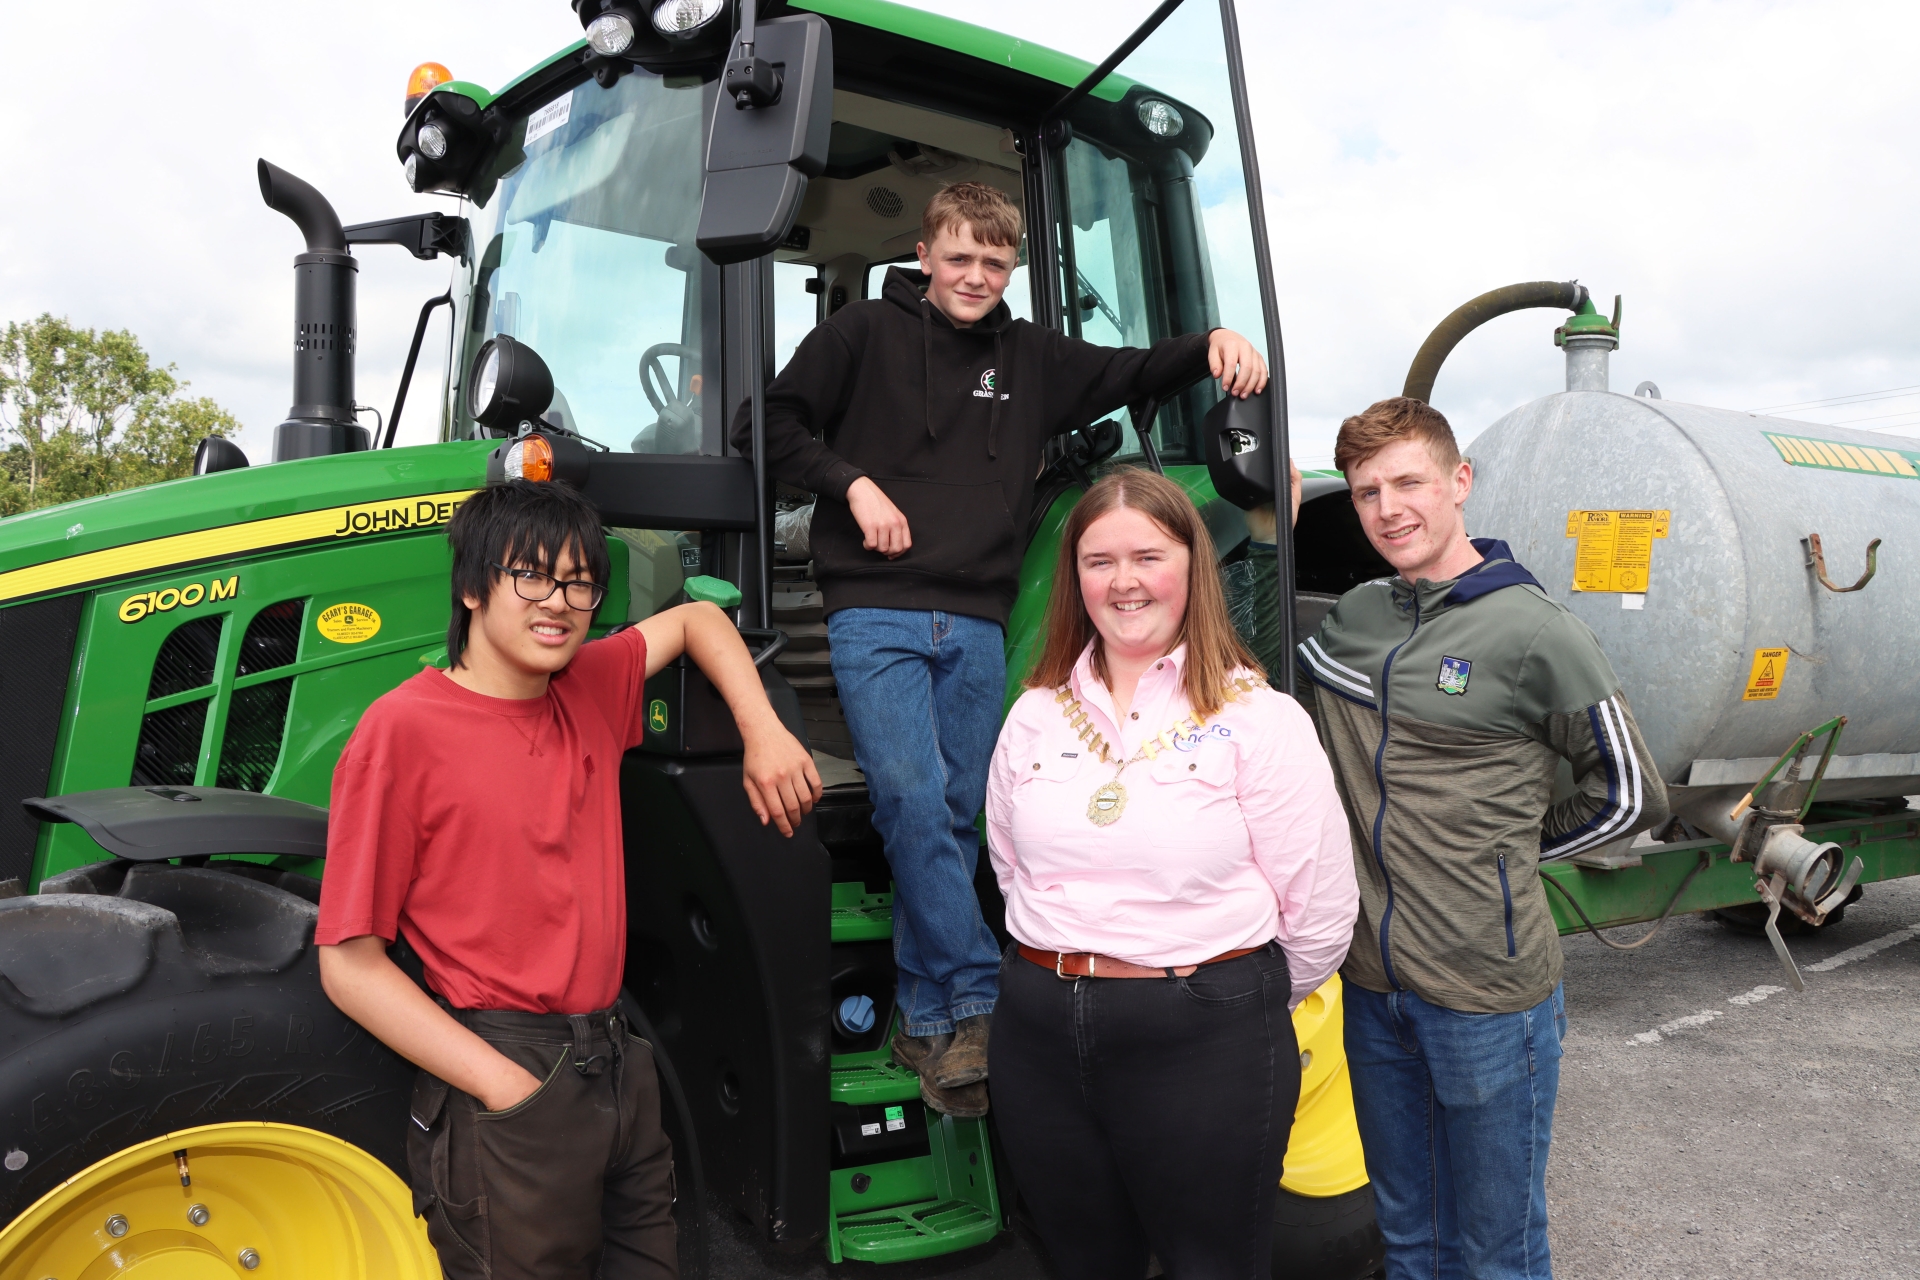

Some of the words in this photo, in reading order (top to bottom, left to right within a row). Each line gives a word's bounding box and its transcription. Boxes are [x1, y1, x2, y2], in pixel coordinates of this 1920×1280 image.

[973, 390, 1010, 400] GRASEN
[336, 507, 409, 534] JOHN
[118, 582, 206, 624] 6100
[209, 575, 240, 603] M
[322, 606, 347, 622] GEARY'S
[350, 606, 373, 619] GARAGE
